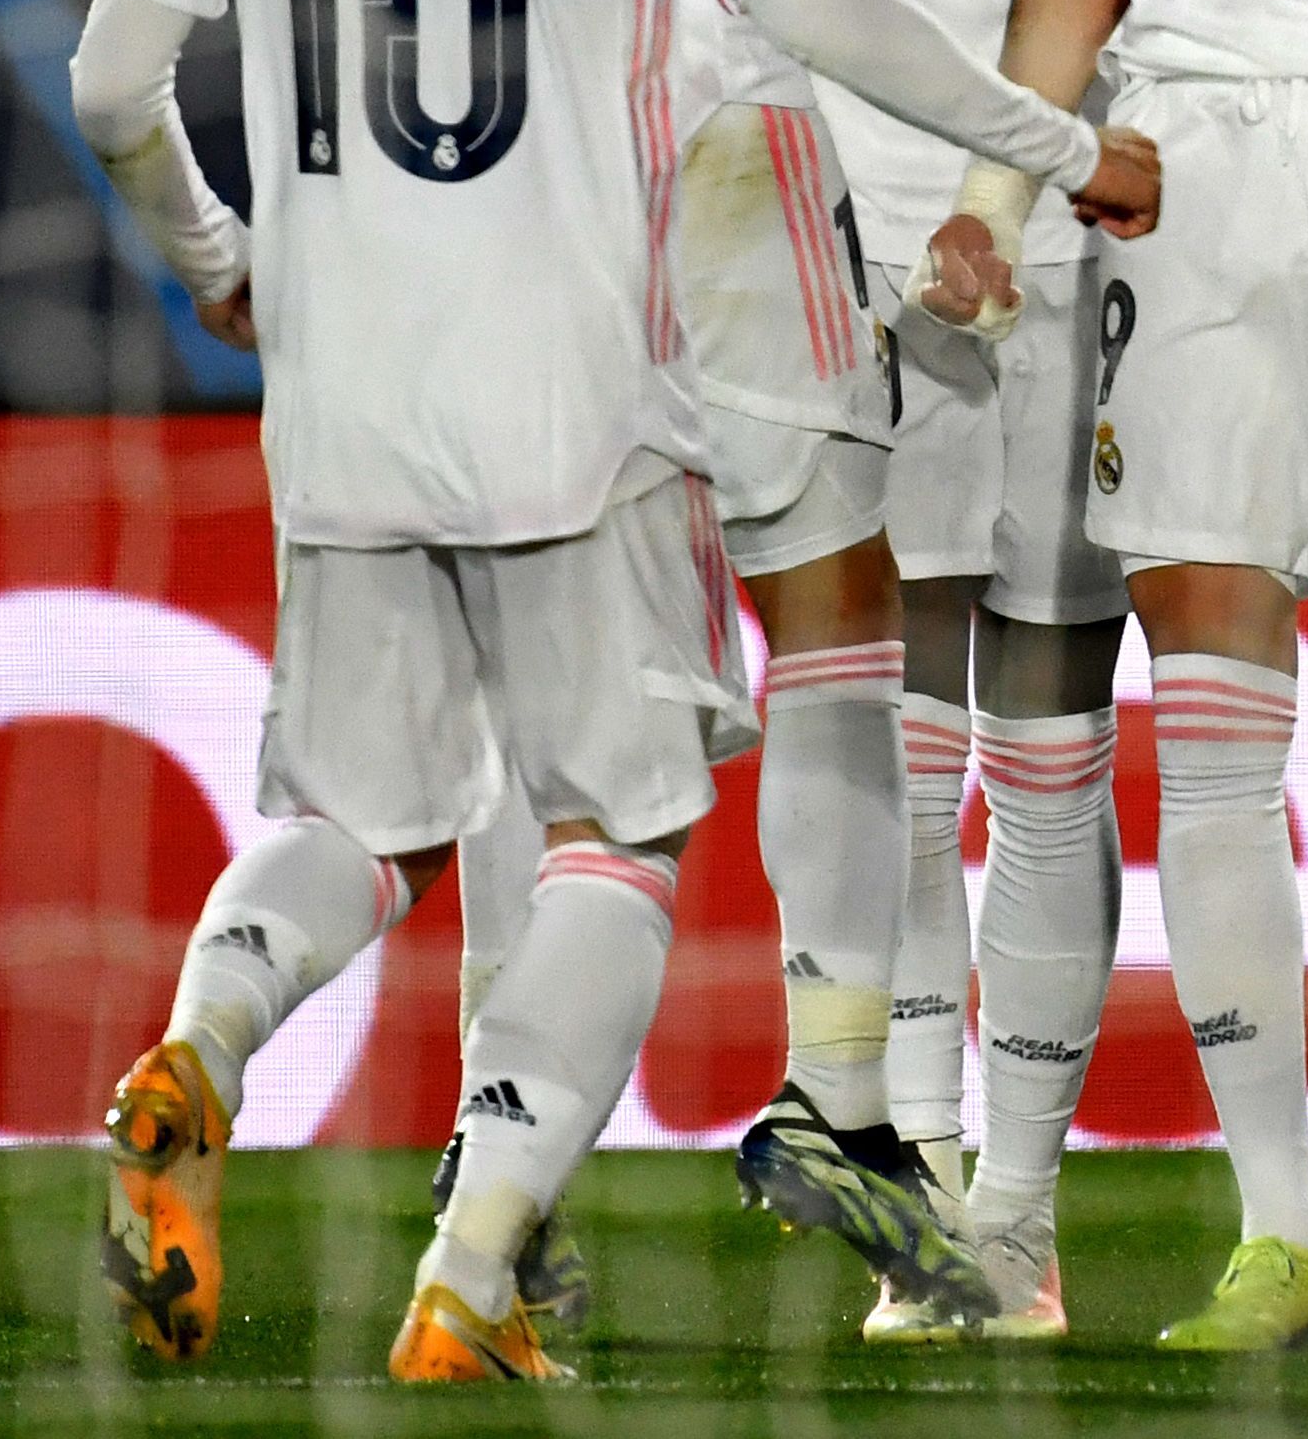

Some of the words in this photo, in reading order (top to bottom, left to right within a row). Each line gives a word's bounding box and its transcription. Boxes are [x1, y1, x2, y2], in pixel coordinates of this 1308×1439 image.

[1097, 278, 1136, 405] 9
[891, 1002, 958, 1021] ADRID
[992, 1038, 1083, 1062] MADRID
[1007, 1034, 1067, 1052] REAL
